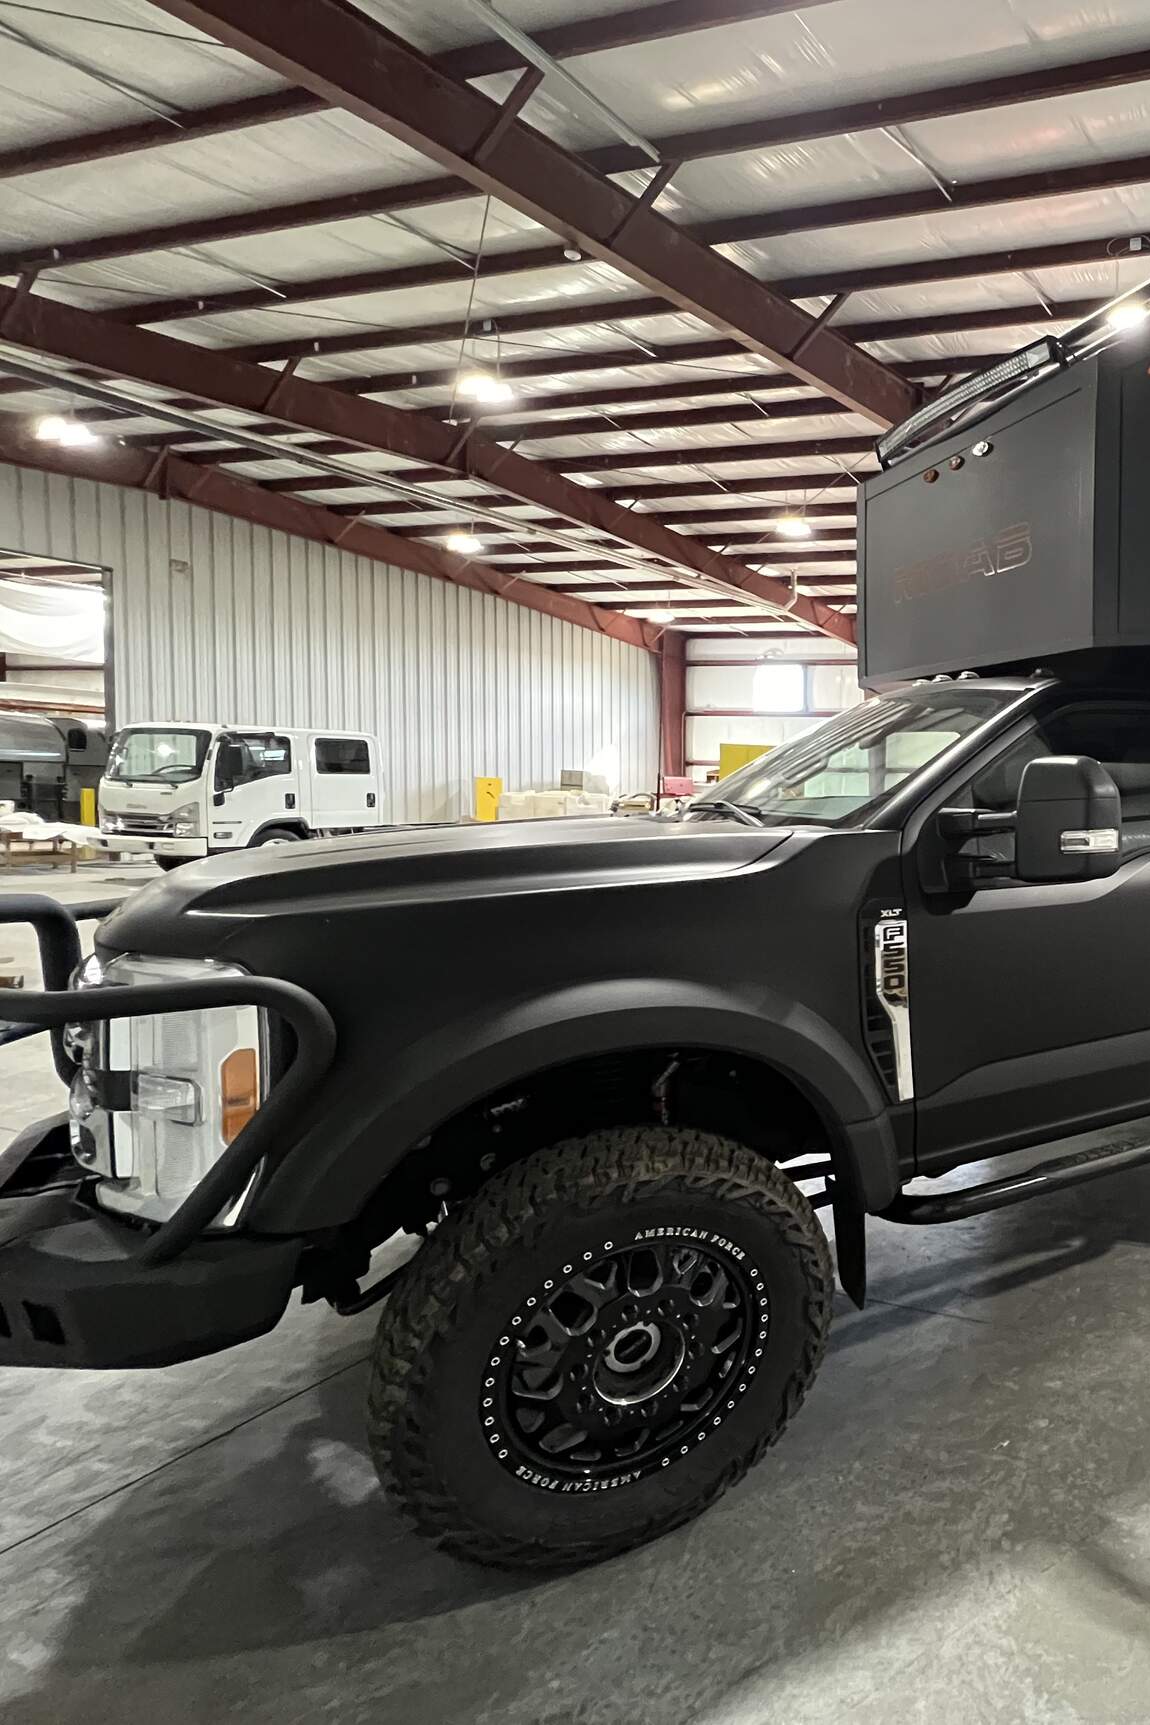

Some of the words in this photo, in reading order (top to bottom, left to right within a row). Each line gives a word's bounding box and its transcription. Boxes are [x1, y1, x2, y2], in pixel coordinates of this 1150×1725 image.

[880, 908, 903, 919] XLT
[634, 1226, 709, 1241] AMERICAN
[710, 1234, 746, 1261] FORCE
[515, 1465, 559, 1490] FORCE
[561, 1470, 641, 1493] AMERICAN
